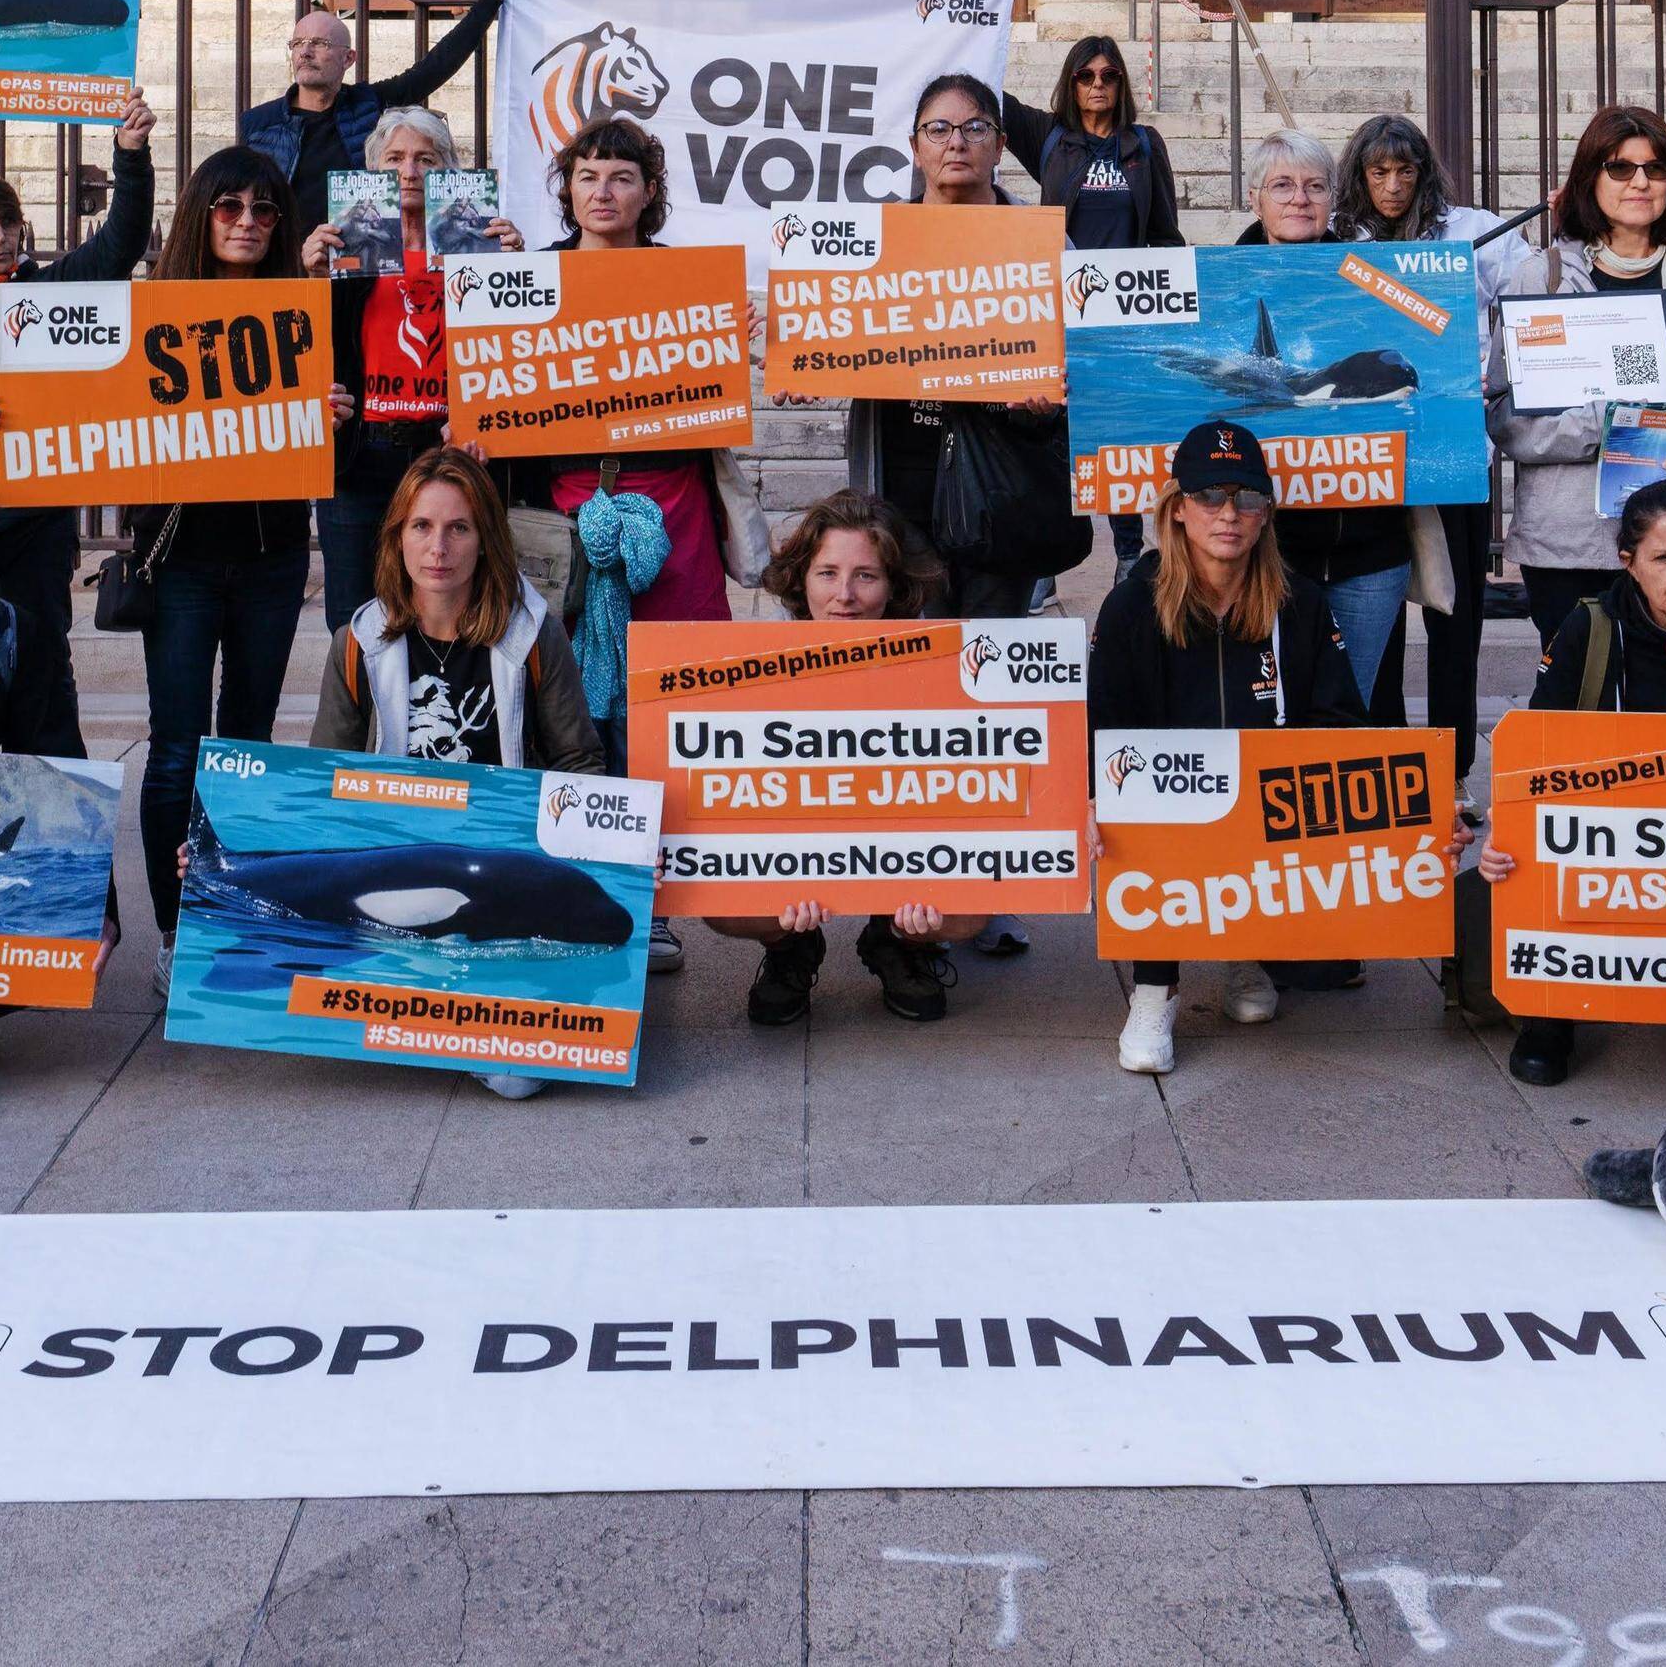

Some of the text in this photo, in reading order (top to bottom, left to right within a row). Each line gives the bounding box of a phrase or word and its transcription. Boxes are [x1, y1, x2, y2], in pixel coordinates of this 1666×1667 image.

[948, 10, 999, 26] VOICE
[12, 77, 43, 92] PAS
[47, 78, 126, 96] TENERIFE
[690, 57, 878, 135] ONE
[331, 174, 389, 188] REJOIGNEZ
[429, 173, 486, 187] REJOIGNEZ
[684, 132, 921, 210] VOIC
[812, 221, 855, 237] ONE
[811, 239, 876, 257] VOICE
[1395, 251, 1468, 274] Wikie
[488, 271, 534, 289] ONE
[774, 262, 1053, 308] UN SANCTUAIRE
[1115, 268, 1170, 292] ONE
[489, 289, 556, 308] VOICE
[1116, 291, 1198, 316] VOICE
[1346, 260, 1448, 331] PAS TENERIFE
[48, 306, 98, 325] ONE
[778, 292, 1056, 342] PAS LE JAPON
[48, 326, 120, 346] VOICE
[454, 302, 737, 367] UN SANCTUAIRE
[144, 309, 313, 406] STOP
[459, 334, 741, 403] PAS LE JAPON
[792, 338, 1037, 371] #StopDelphinarium
[367, 369, 448, 398] one voi
[922, 366, 1059, 389] ET PAS TENERIFE
[365, 396, 449, 414] #ÉgalitéAnim
[478, 383, 723, 432] #StopDelphinarium
[611, 406, 747, 440] ET PAS TENERIFE
[3, 399, 325, 481] DELPHINARIUM
[1105, 436, 1394, 477] UN STUAIRE
[1109, 481, 1165, 513] PA
[659, 634, 931, 693] #StopDelphinarium
[1007, 642, 1058, 662] ONE
[1007, 663, 1082, 684] VOICE
[674, 716, 1043, 759] Un Sanctuaire
[204, 751, 266, 779] Keijo
[1153, 753, 1205, 772] ONE
[339, 777, 468, 802] PAS TENERIFE
[703, 768, 1017, 808] PAS LE JAPON
[1153, 774, 1229, 794] VOICE
[1261, 762, 1429, 833] STOP
[586, 793, 629, 813] ONE
[585, 812, 647, 833] VOICE
[1543, 814, 1616, 857] Un
[1106, 834, 1446, 935] Captivité
[322, 988, 605, 1034] #StopDelphinarium
[367, 1024, 628, 1067] #SauvonsNosOrques
[21, 1309, 1648, 1379] STOP DELPHINARIUM
